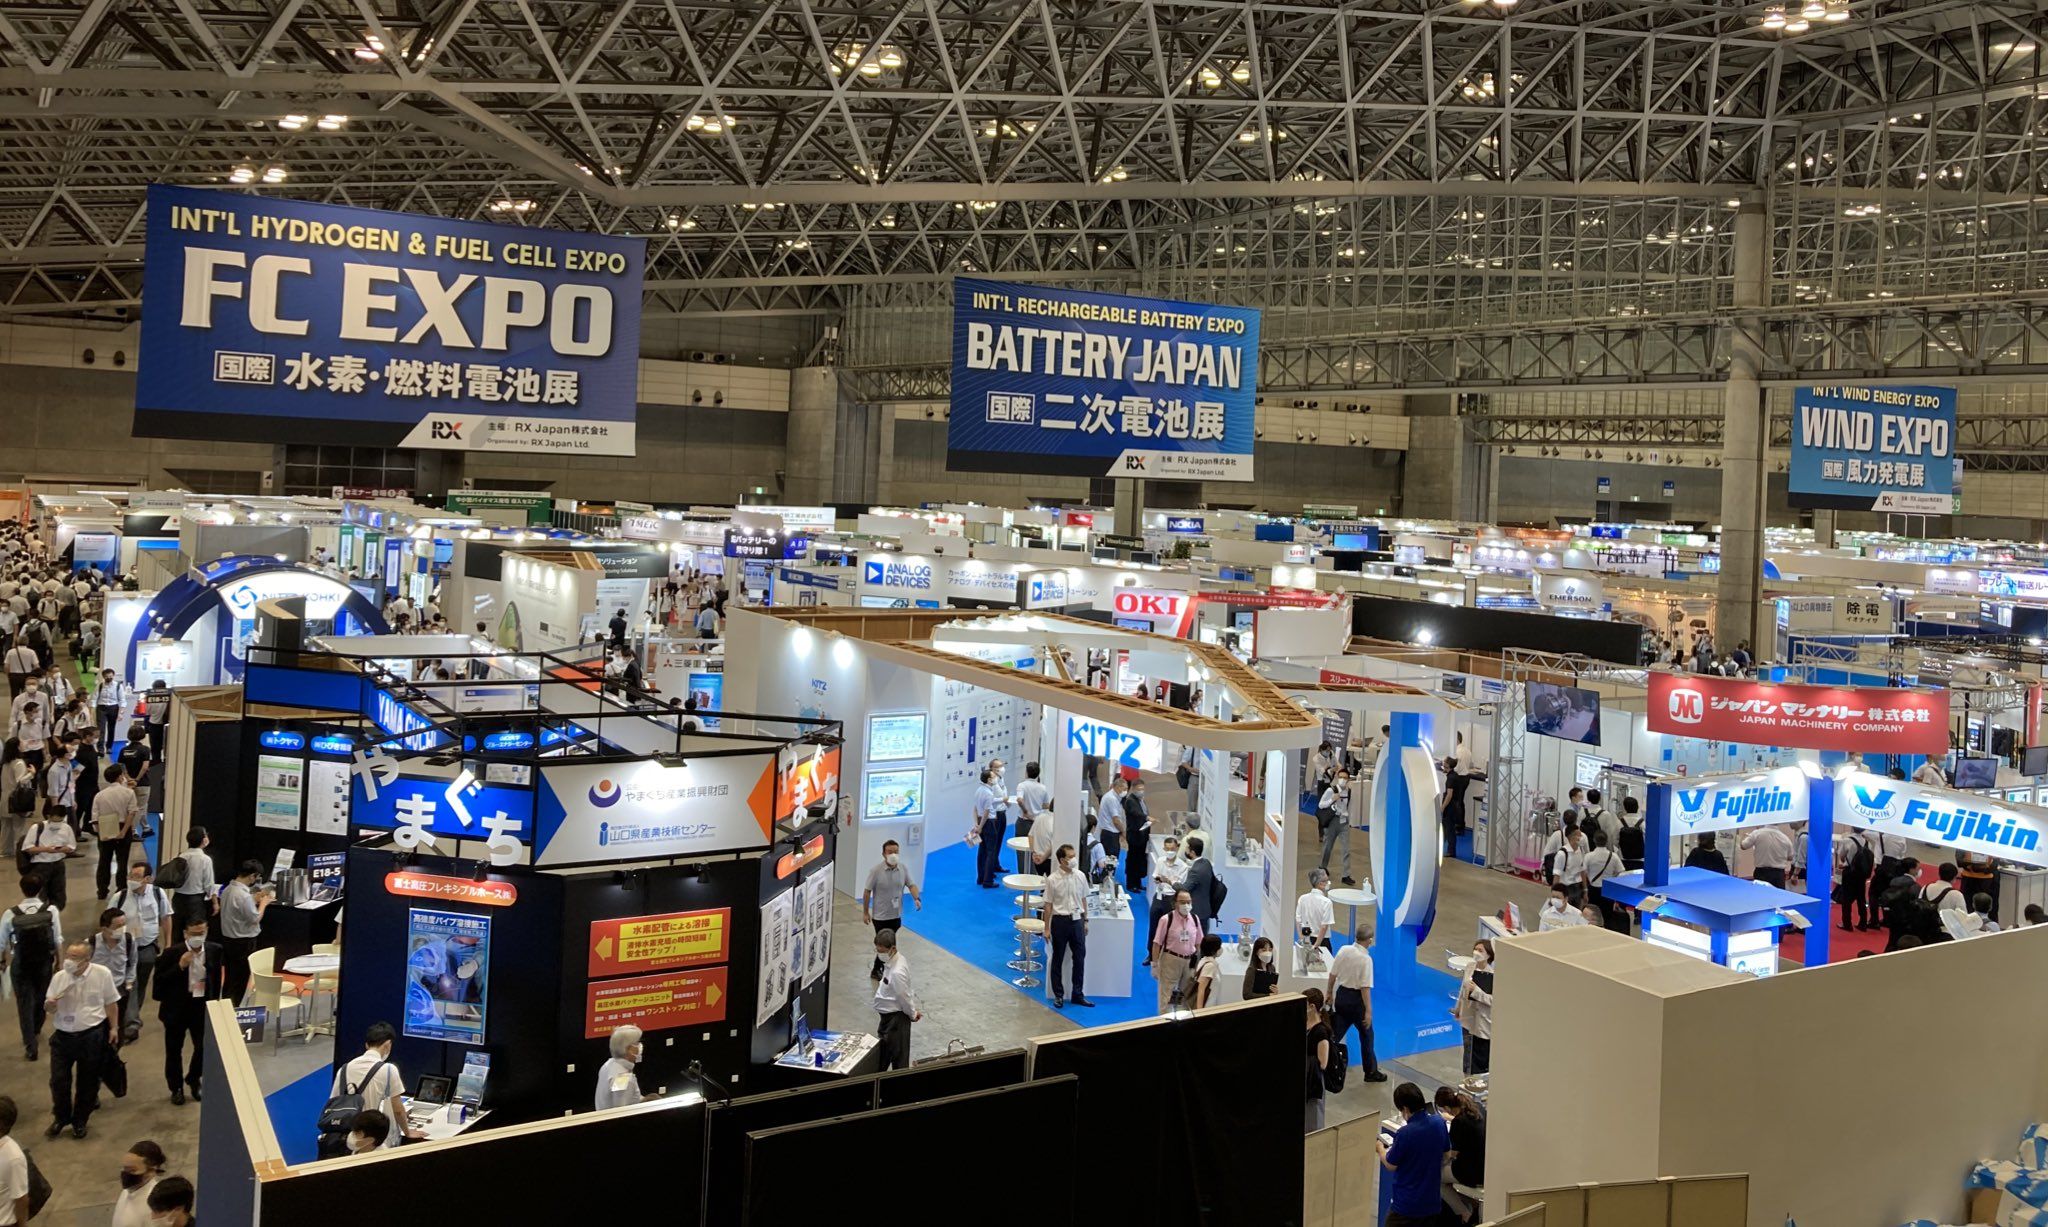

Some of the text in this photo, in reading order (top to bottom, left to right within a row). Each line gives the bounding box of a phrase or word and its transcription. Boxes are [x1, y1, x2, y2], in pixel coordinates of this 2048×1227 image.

[170, 206, 625, 275] INT'L HYDROGEN & FUEL CELL EXPO
[180, 246, 614, 357] FC EXPO
[973, 293, 1245, 335] INT'L RECHARGEABLE BATTERY EXPO
[967, 322, 1242, 389] BATTERY JAPAN
[217, 356, 271, 381] 国際
[1842, 387, 1870, 401] WIND
[1873, 390, 1912, 406] ENERGY
[1914, 394, 1940, 409] EXPO
[514, 422, 532, 433] RX
[989, 392, 1225, 441] 国際 二次電池展
[432, 420, 463, 440] RX
[1801, 406, 1949, 457] WIND EXPO
[531, 438, 544, 446] RX
[544, 438, 573, 449] Japan
[1126, 455, 1146, 471] RX
[1823, 458, 1925, 487] 国際 風力発電展
[1169, 520, 1201, 529] NOKIA
[886, 563, 931, 577] ANALOG
[886, 575, 930, 588] DEVICES
[1115, 593, 1179, 616] OKI
[1549, 594, 1592, 602] EMERSON
[1739, 715, 1905, 733] JAPAN MACHINERY COMPANY
[1868, 707, 1931, 723] 株式会社
[1067, 716, 1142, 770] KITZ
[625, 784, 729, 802] やまぐち産業振興財団
[779, 743, 838, 828] やまぐち
[352, 744, 523, 866] やまぐち
[1712, 786, 1791, 823] Fujikin
[1854, 803, 1890, 819] FUJIKIN
[610, 823, 717, 842] 山口県産業技術センター
[1902, 799, 2039, 851] Fujikin
[313, 867, 341, 878] E18-5
